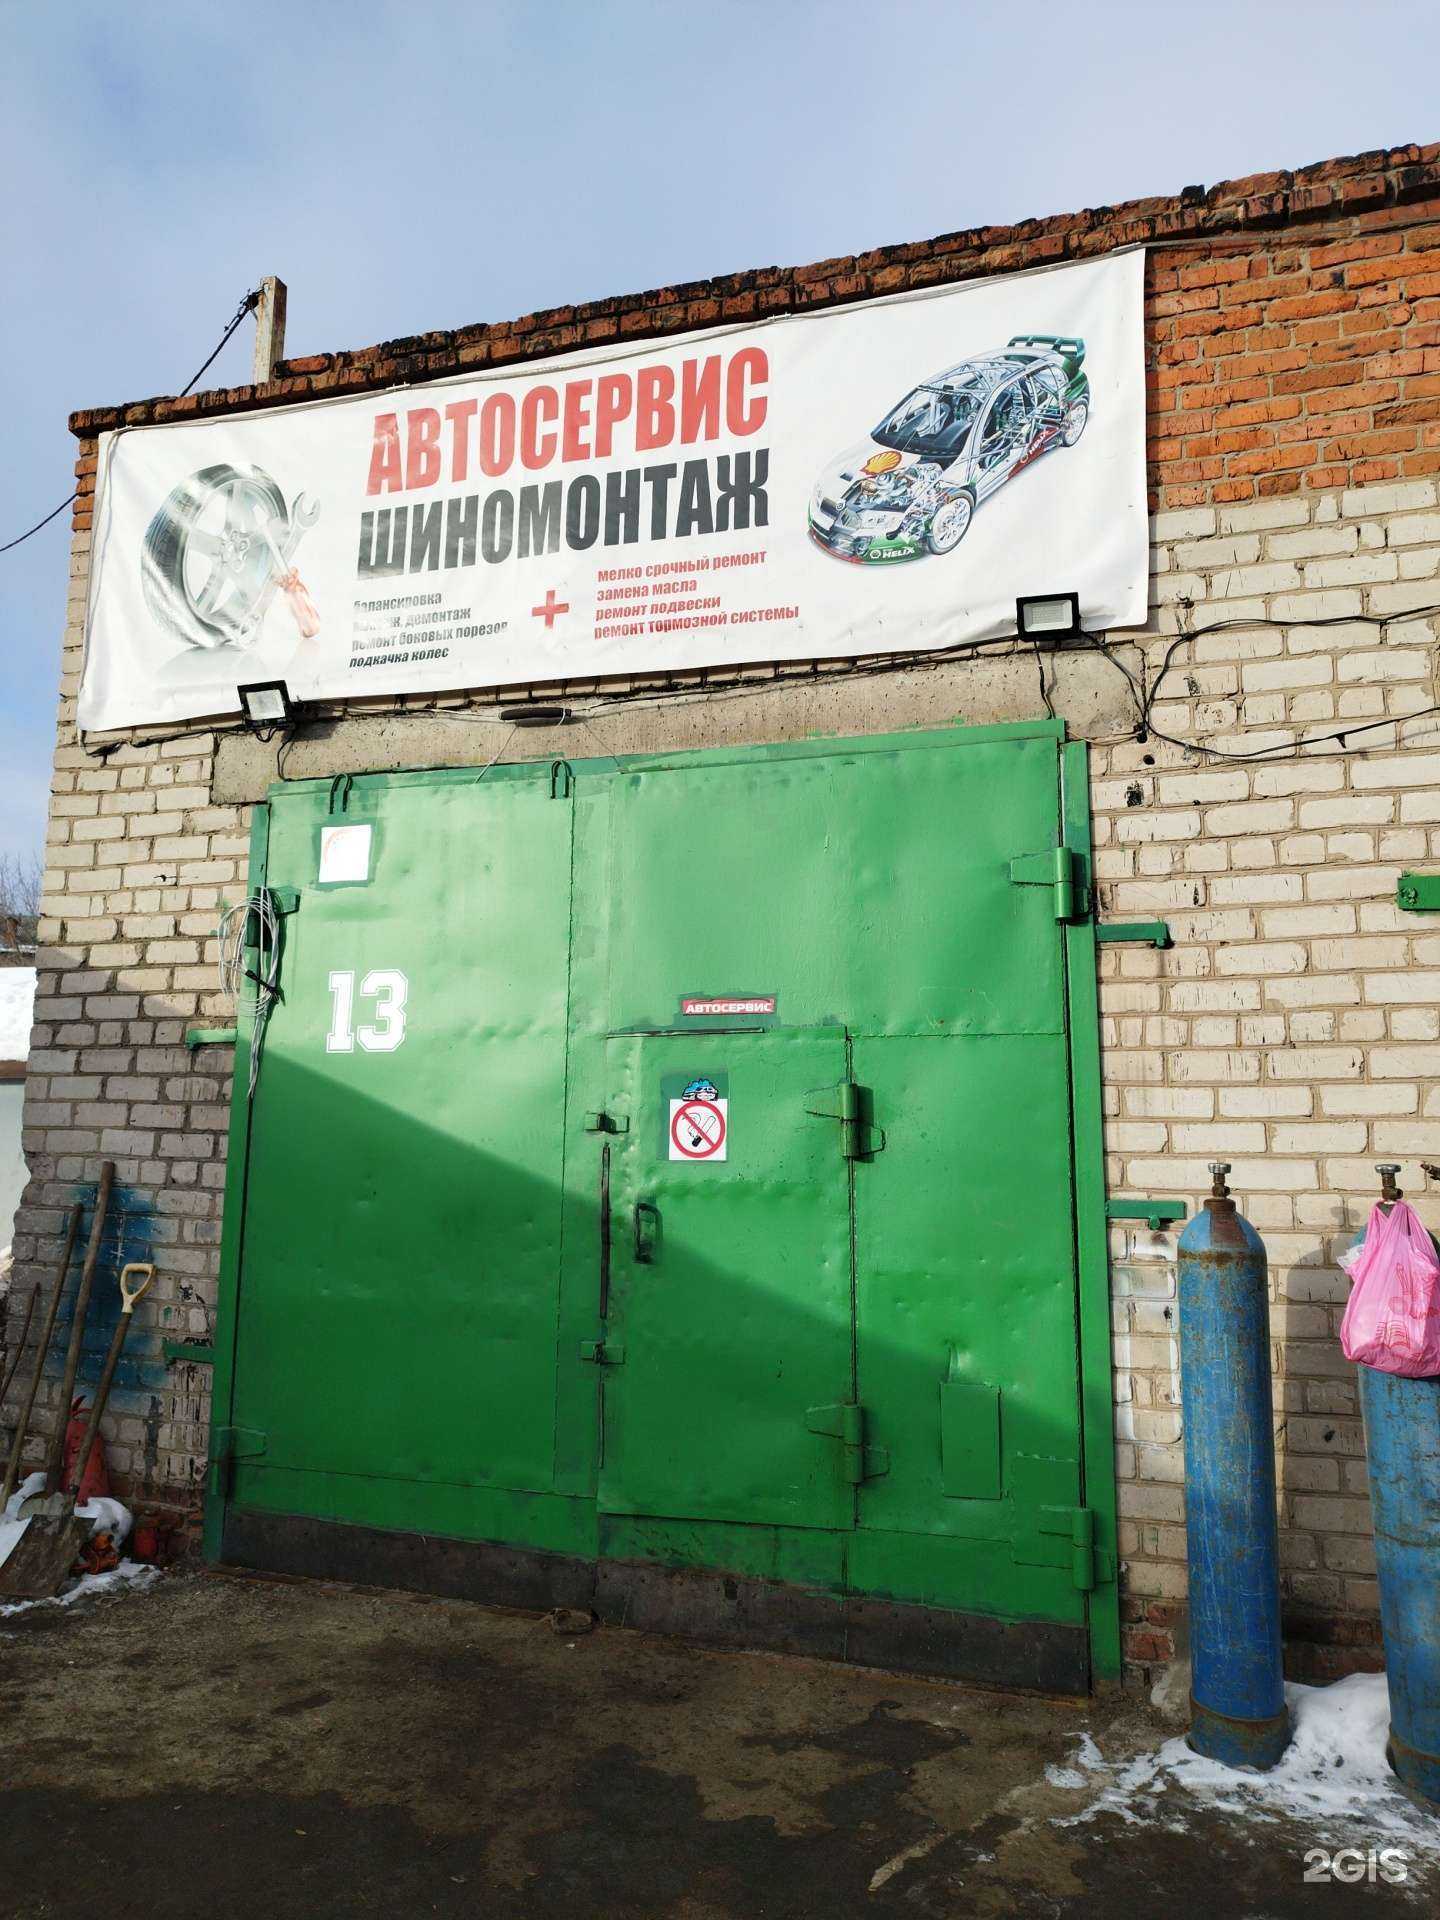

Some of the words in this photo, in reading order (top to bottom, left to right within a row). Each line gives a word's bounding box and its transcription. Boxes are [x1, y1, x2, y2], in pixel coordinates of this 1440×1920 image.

[366, 346, 770, 497] АВТОСЕРВИС
[357, 447, 771, 581] ШИНОМОНТАЖ
[597, 565, 642, 583] мелко
[645, 555, 710, 578] срочный
[712, 550, 768, 571] ремонт
[596, 584, 649, 602] замена
[652, 579, 698, 596] масла
[593, 621, 645, 640] ремонт
[648, 611, 728, 634] тормозной
[730, 605, 800, 625] системы
[595, 604, 648, 622] ремонт
[650, 596, 721, 614] подвески
[399, 628, 454, 646] боковых
[349, 650, 409, 669] подкачка
[411, 647, 450, 662] колес
[326, 968, 409, 1054] 13
[685, 1002, 772, 1014] АВТОСЕРВИС
